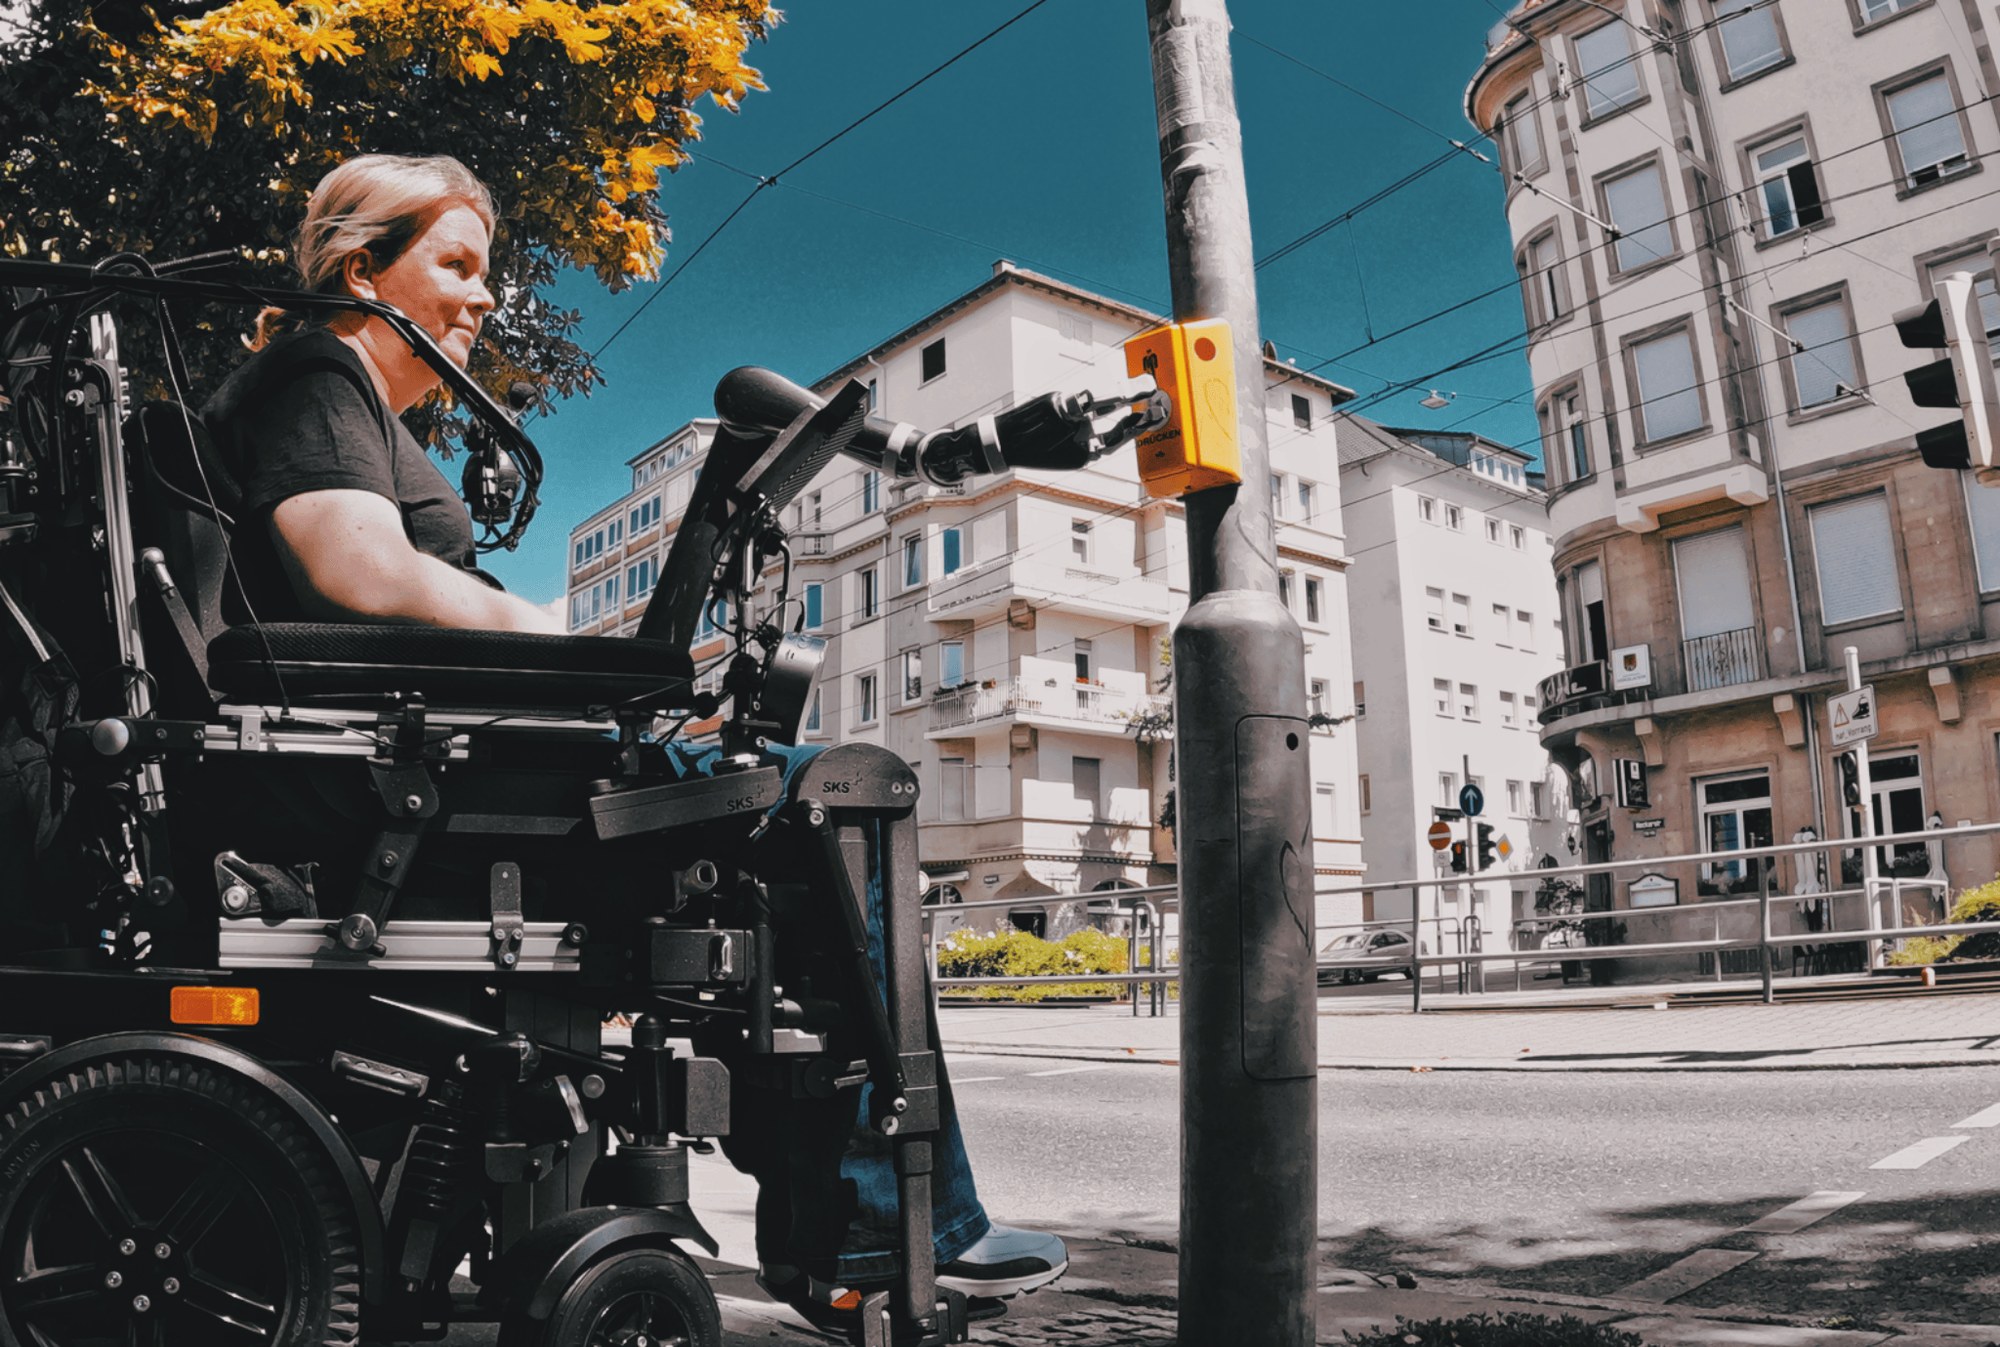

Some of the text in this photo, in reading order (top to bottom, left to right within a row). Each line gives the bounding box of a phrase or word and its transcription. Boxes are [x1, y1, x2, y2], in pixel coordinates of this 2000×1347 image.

[1138, 429, 1181, 447] DRÜCKEN
[823, 781, 850, 793] SKS
[727, 796, 754, 812] SKS
[3, 1139, 41, 1179] NYLON
